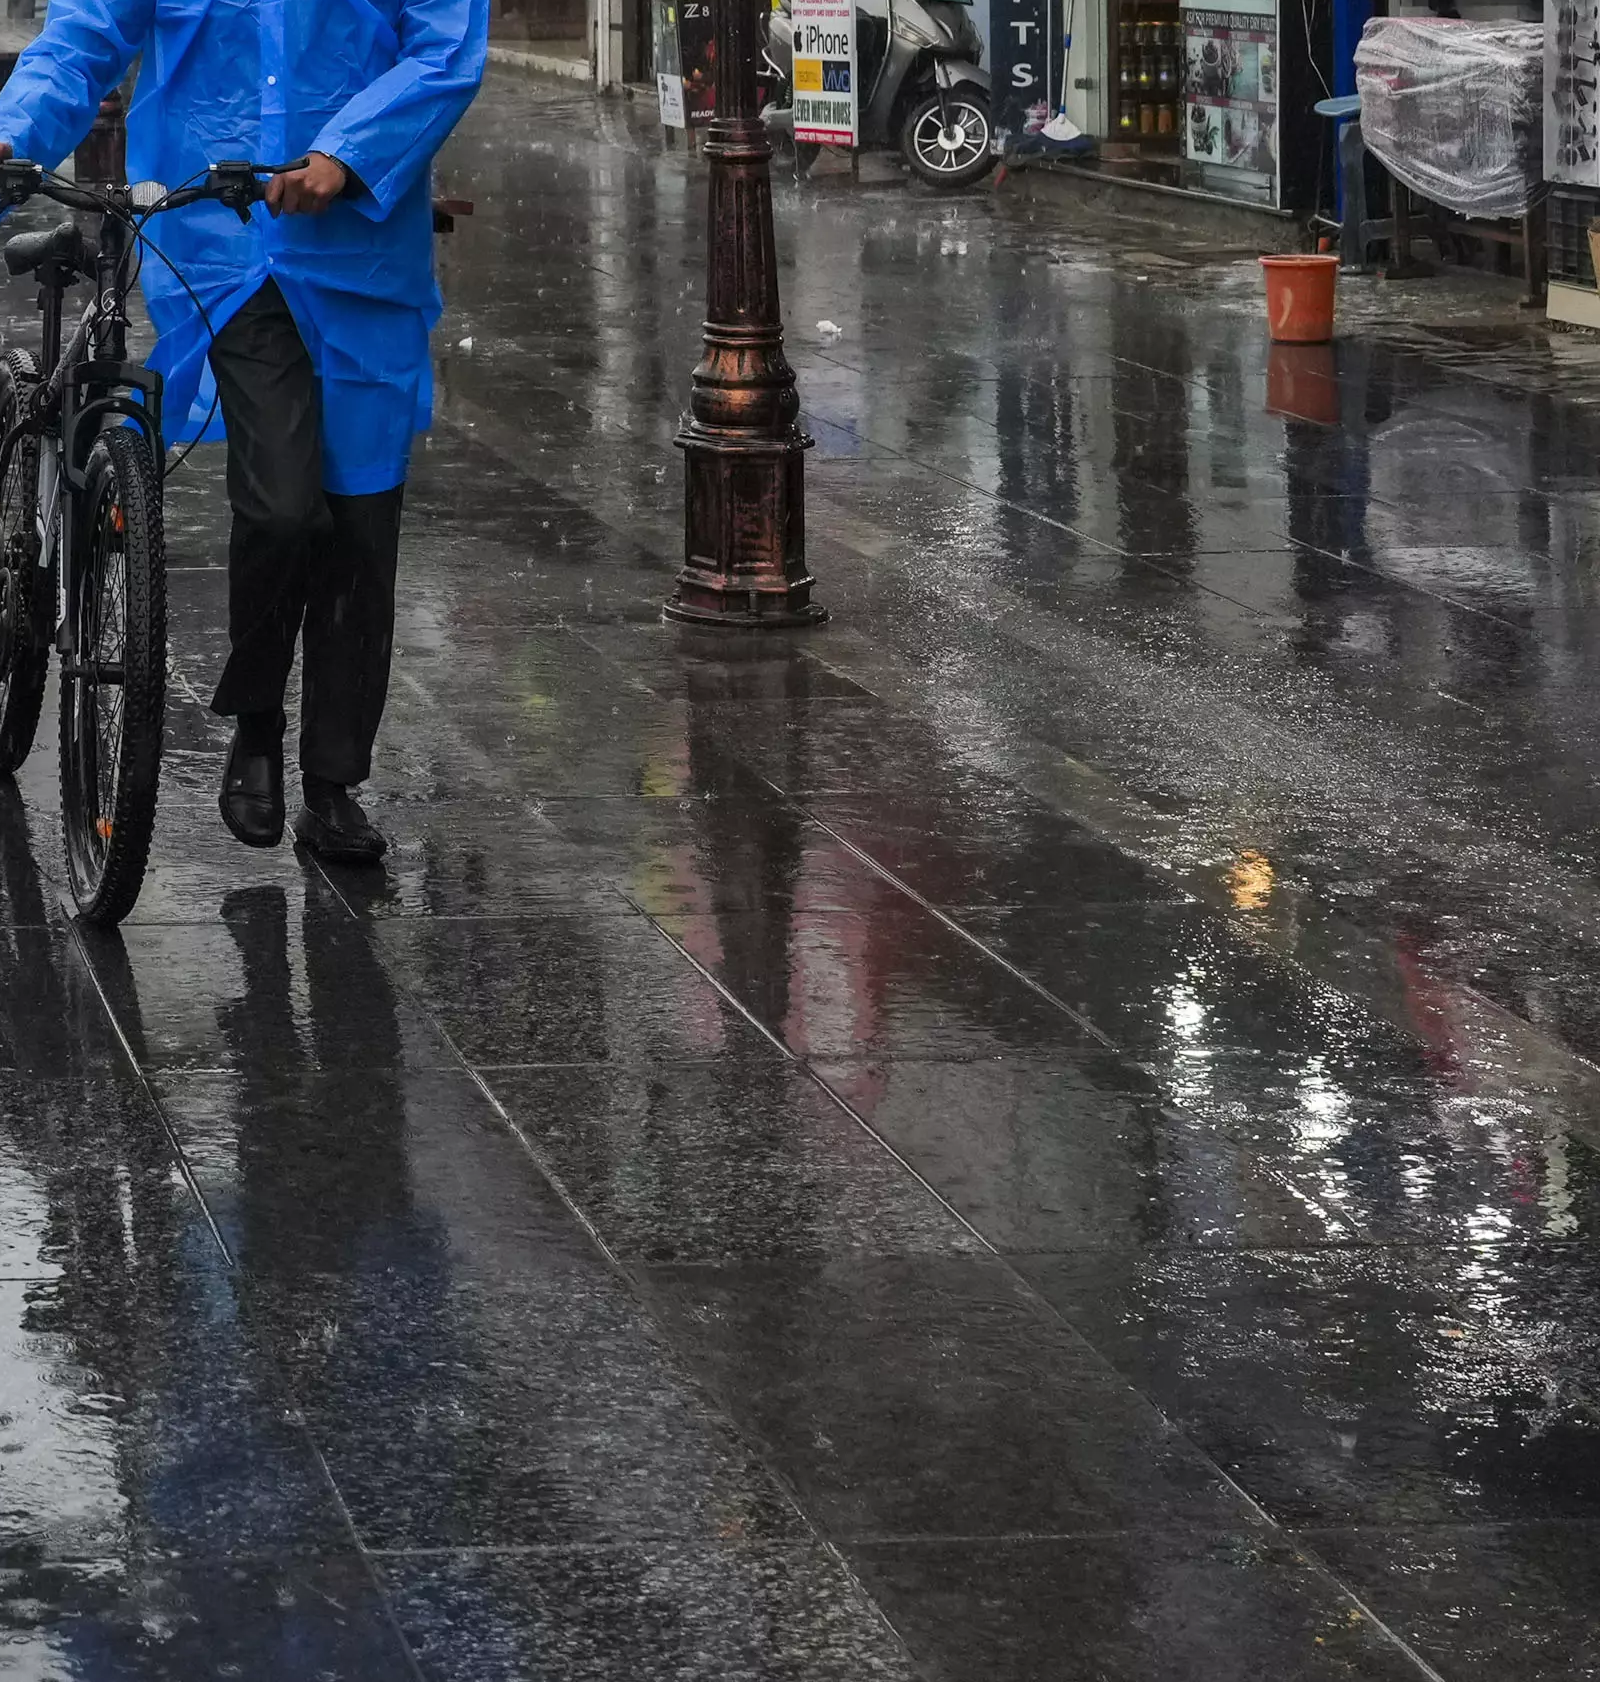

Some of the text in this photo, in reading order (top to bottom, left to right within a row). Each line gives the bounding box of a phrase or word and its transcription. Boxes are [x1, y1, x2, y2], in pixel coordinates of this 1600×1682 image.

[702, 5, 710, 17] 8
[806, 25, 848, 55] iPhone
[691, 110, 714, 119] READY
[794, 98, 851, 126] LEVER WATCH HOUSE
